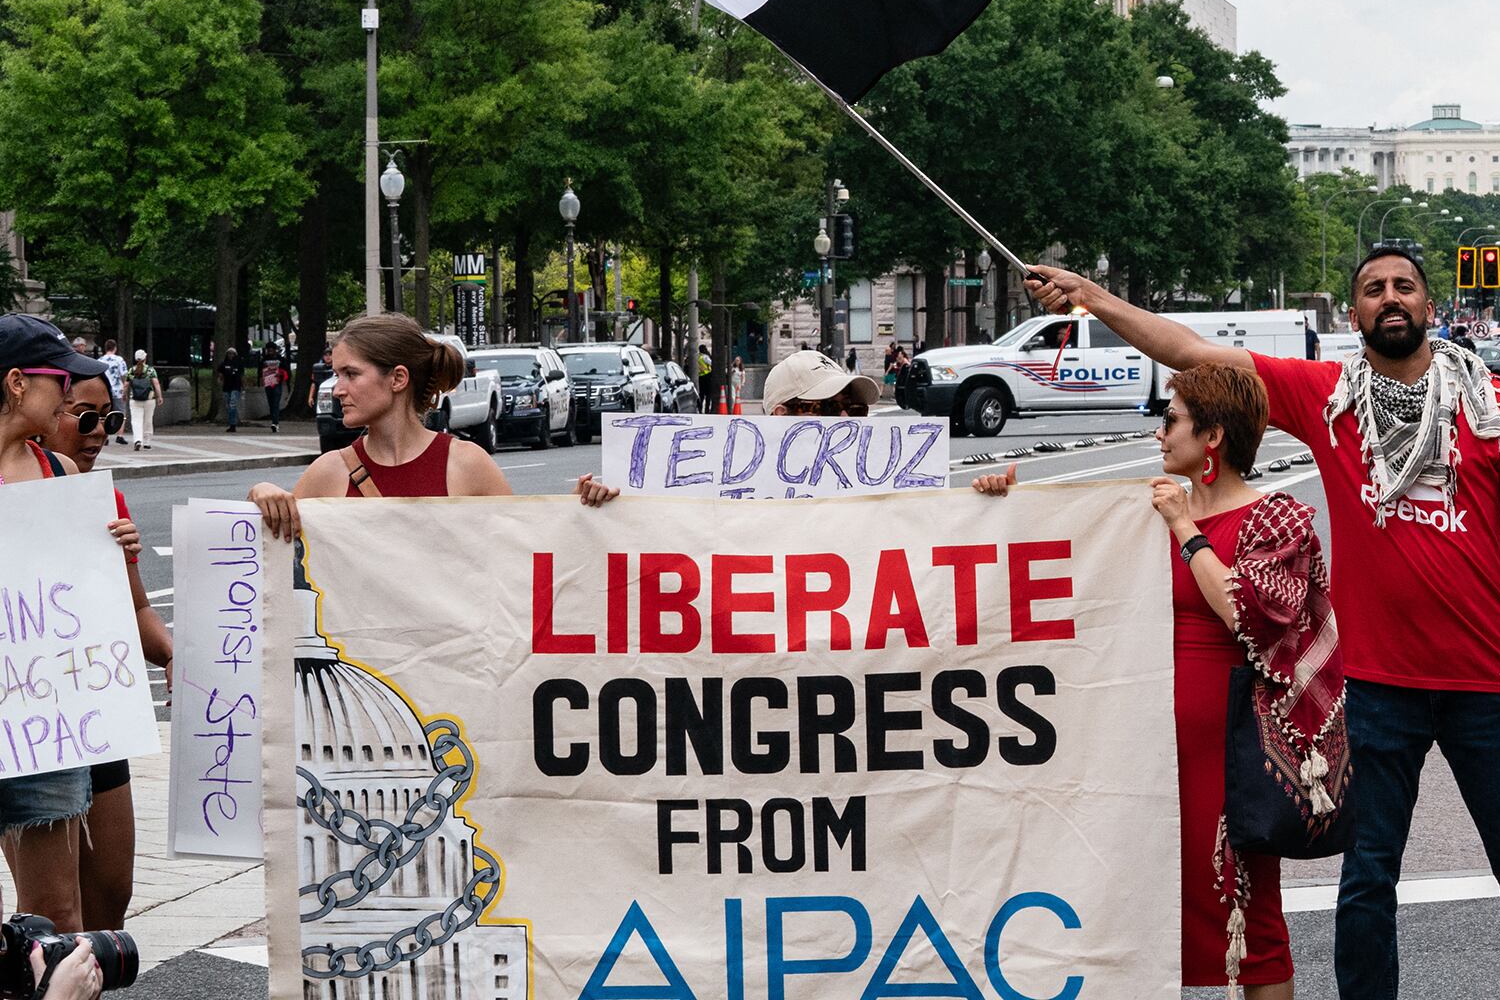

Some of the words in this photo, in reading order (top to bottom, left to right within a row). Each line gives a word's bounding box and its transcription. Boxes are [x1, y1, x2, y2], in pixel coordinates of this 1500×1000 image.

[467, 254, 484, 274] M
[1059, 367, 1140, 381] POLICE
[611, 415, 765, 488] TED
[776, 419, 946, 489] CRUZ
[0, 578, 81, 644] INS
[532, 540, 1076, 654] LIBERATE
[532, 665, 1057, 777] CONGRESS
[193, 688, 257, 836] State
[657, 796, 867, 875] FROM
[577, 892, 1082, 1000] AIPAC
